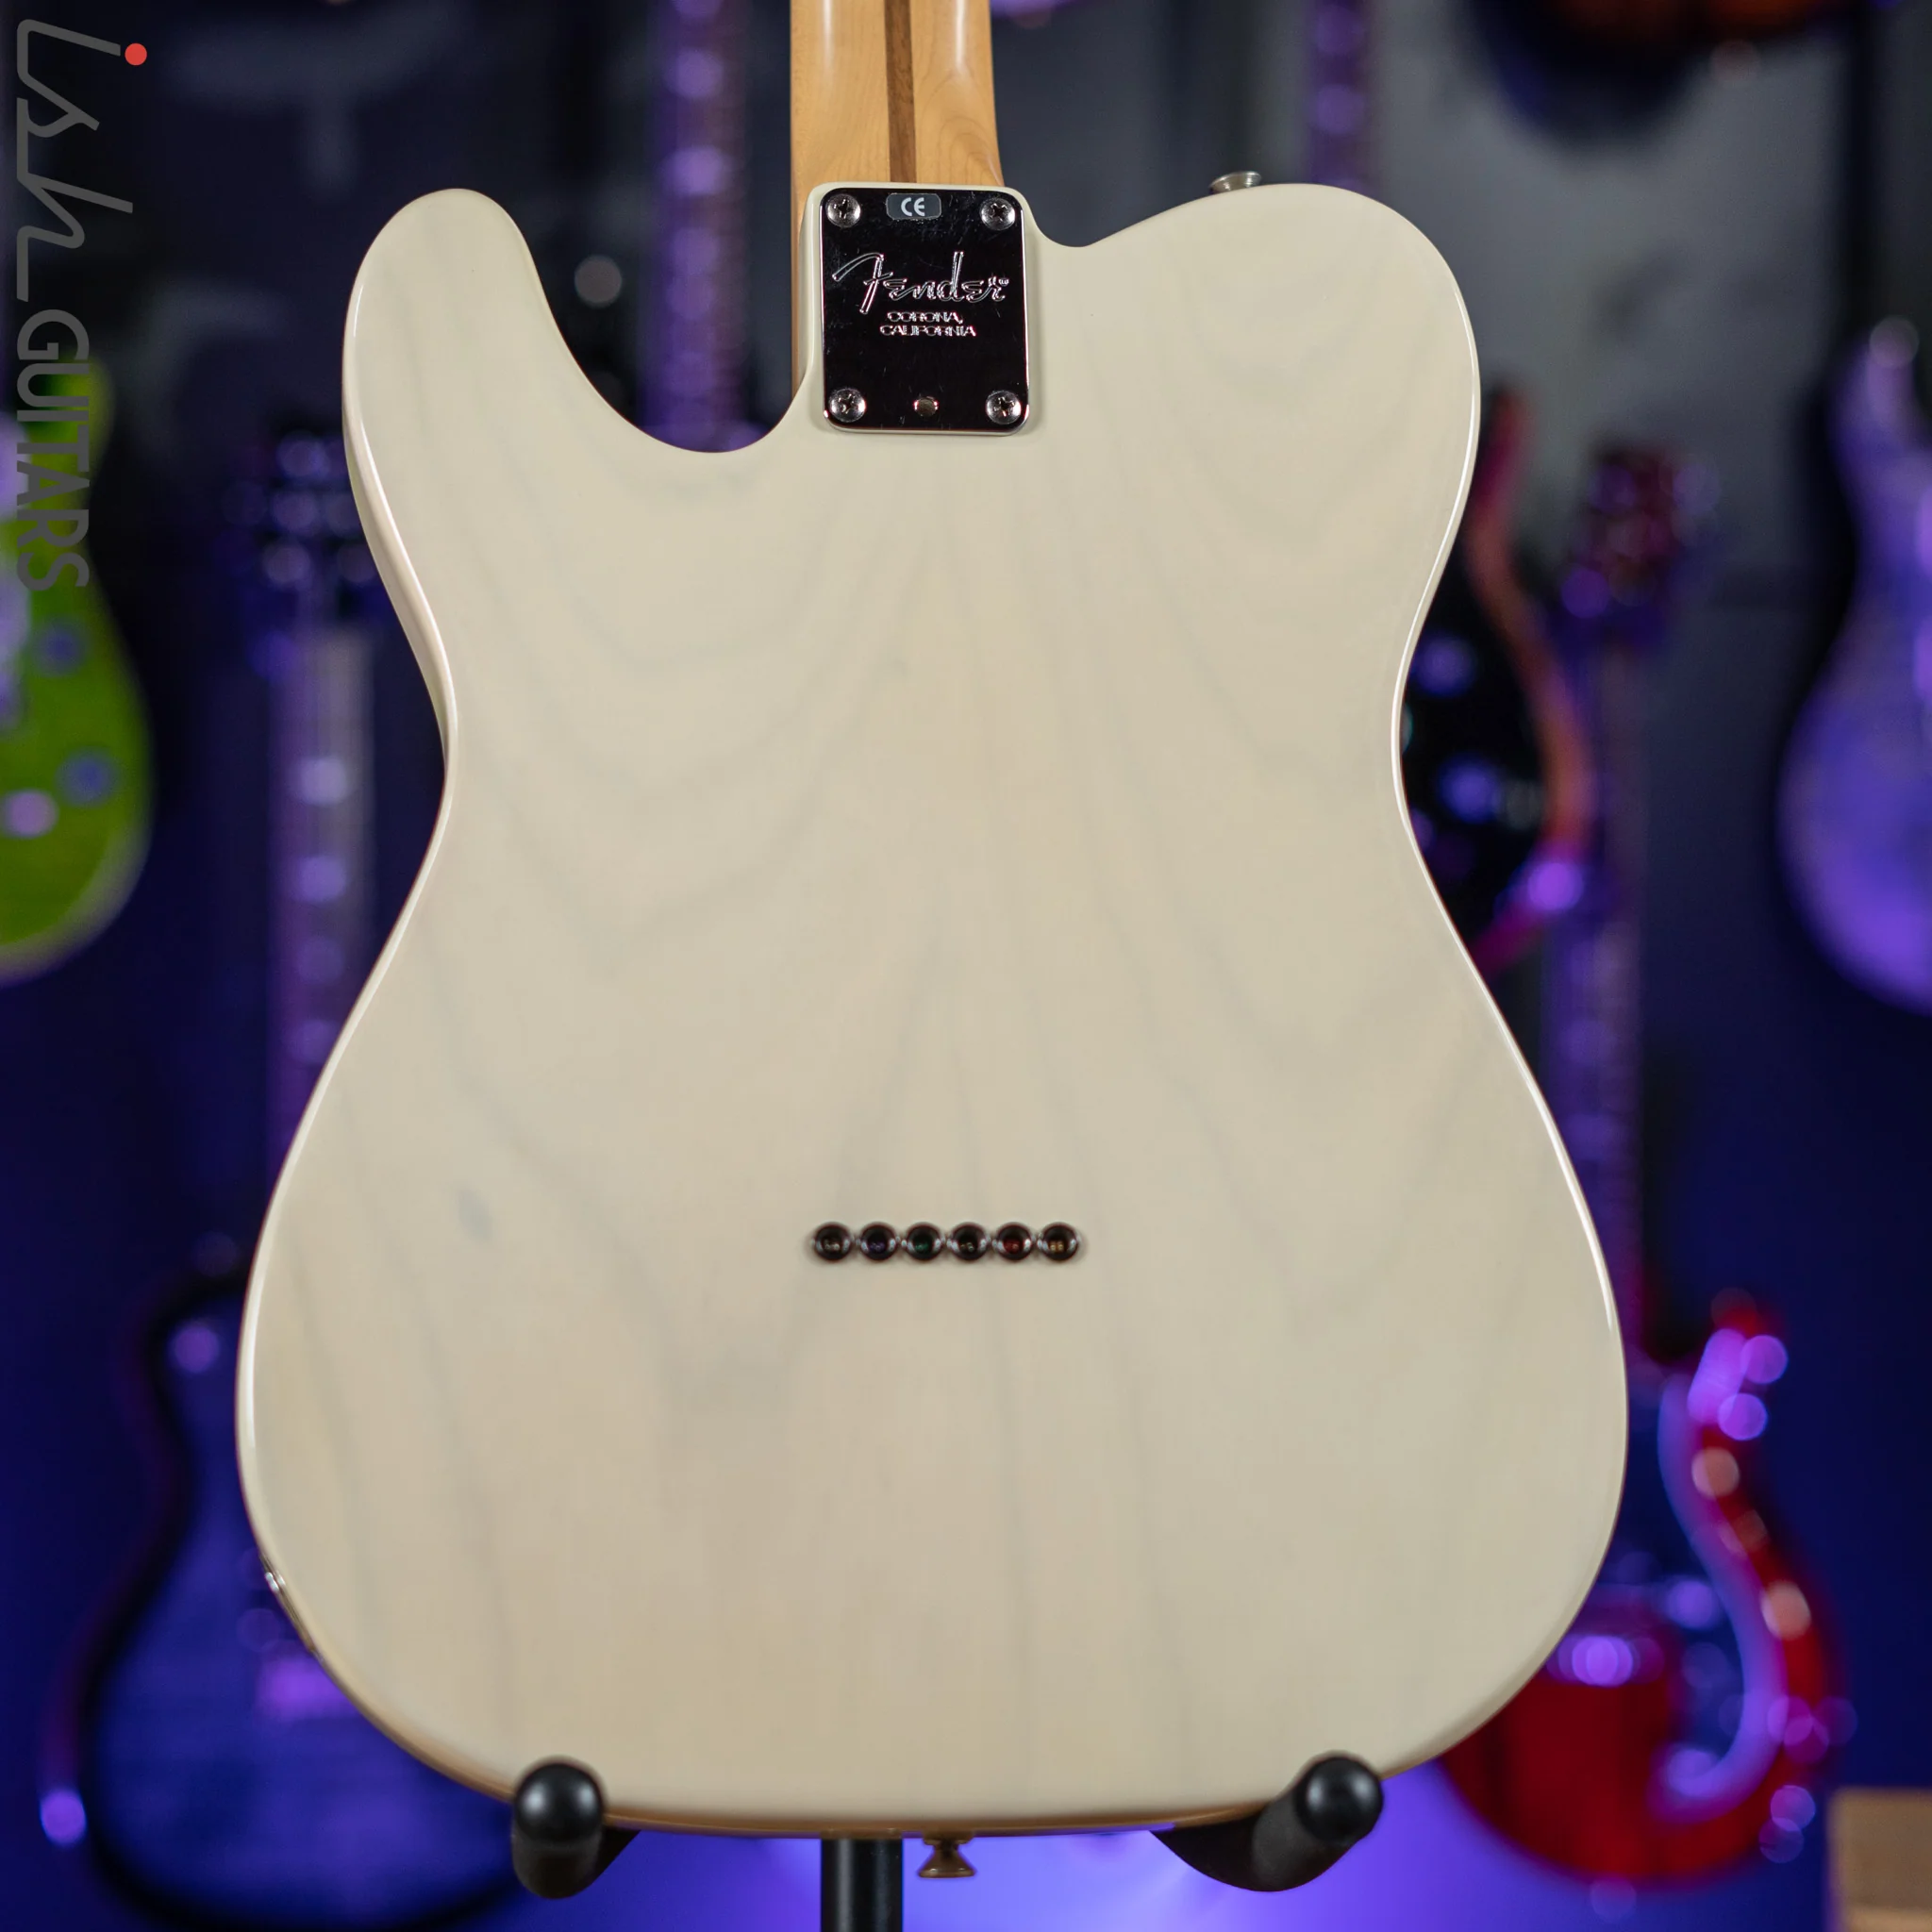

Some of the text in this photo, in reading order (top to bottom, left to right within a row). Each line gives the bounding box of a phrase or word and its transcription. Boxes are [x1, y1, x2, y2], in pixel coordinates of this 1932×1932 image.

[901, 196, 925, 217] CE
[832, 251, 1007, 314] Fender
[887, 310, 963, 324] CORONA,
[879, 325, 976, 337] CALIFORNIA
